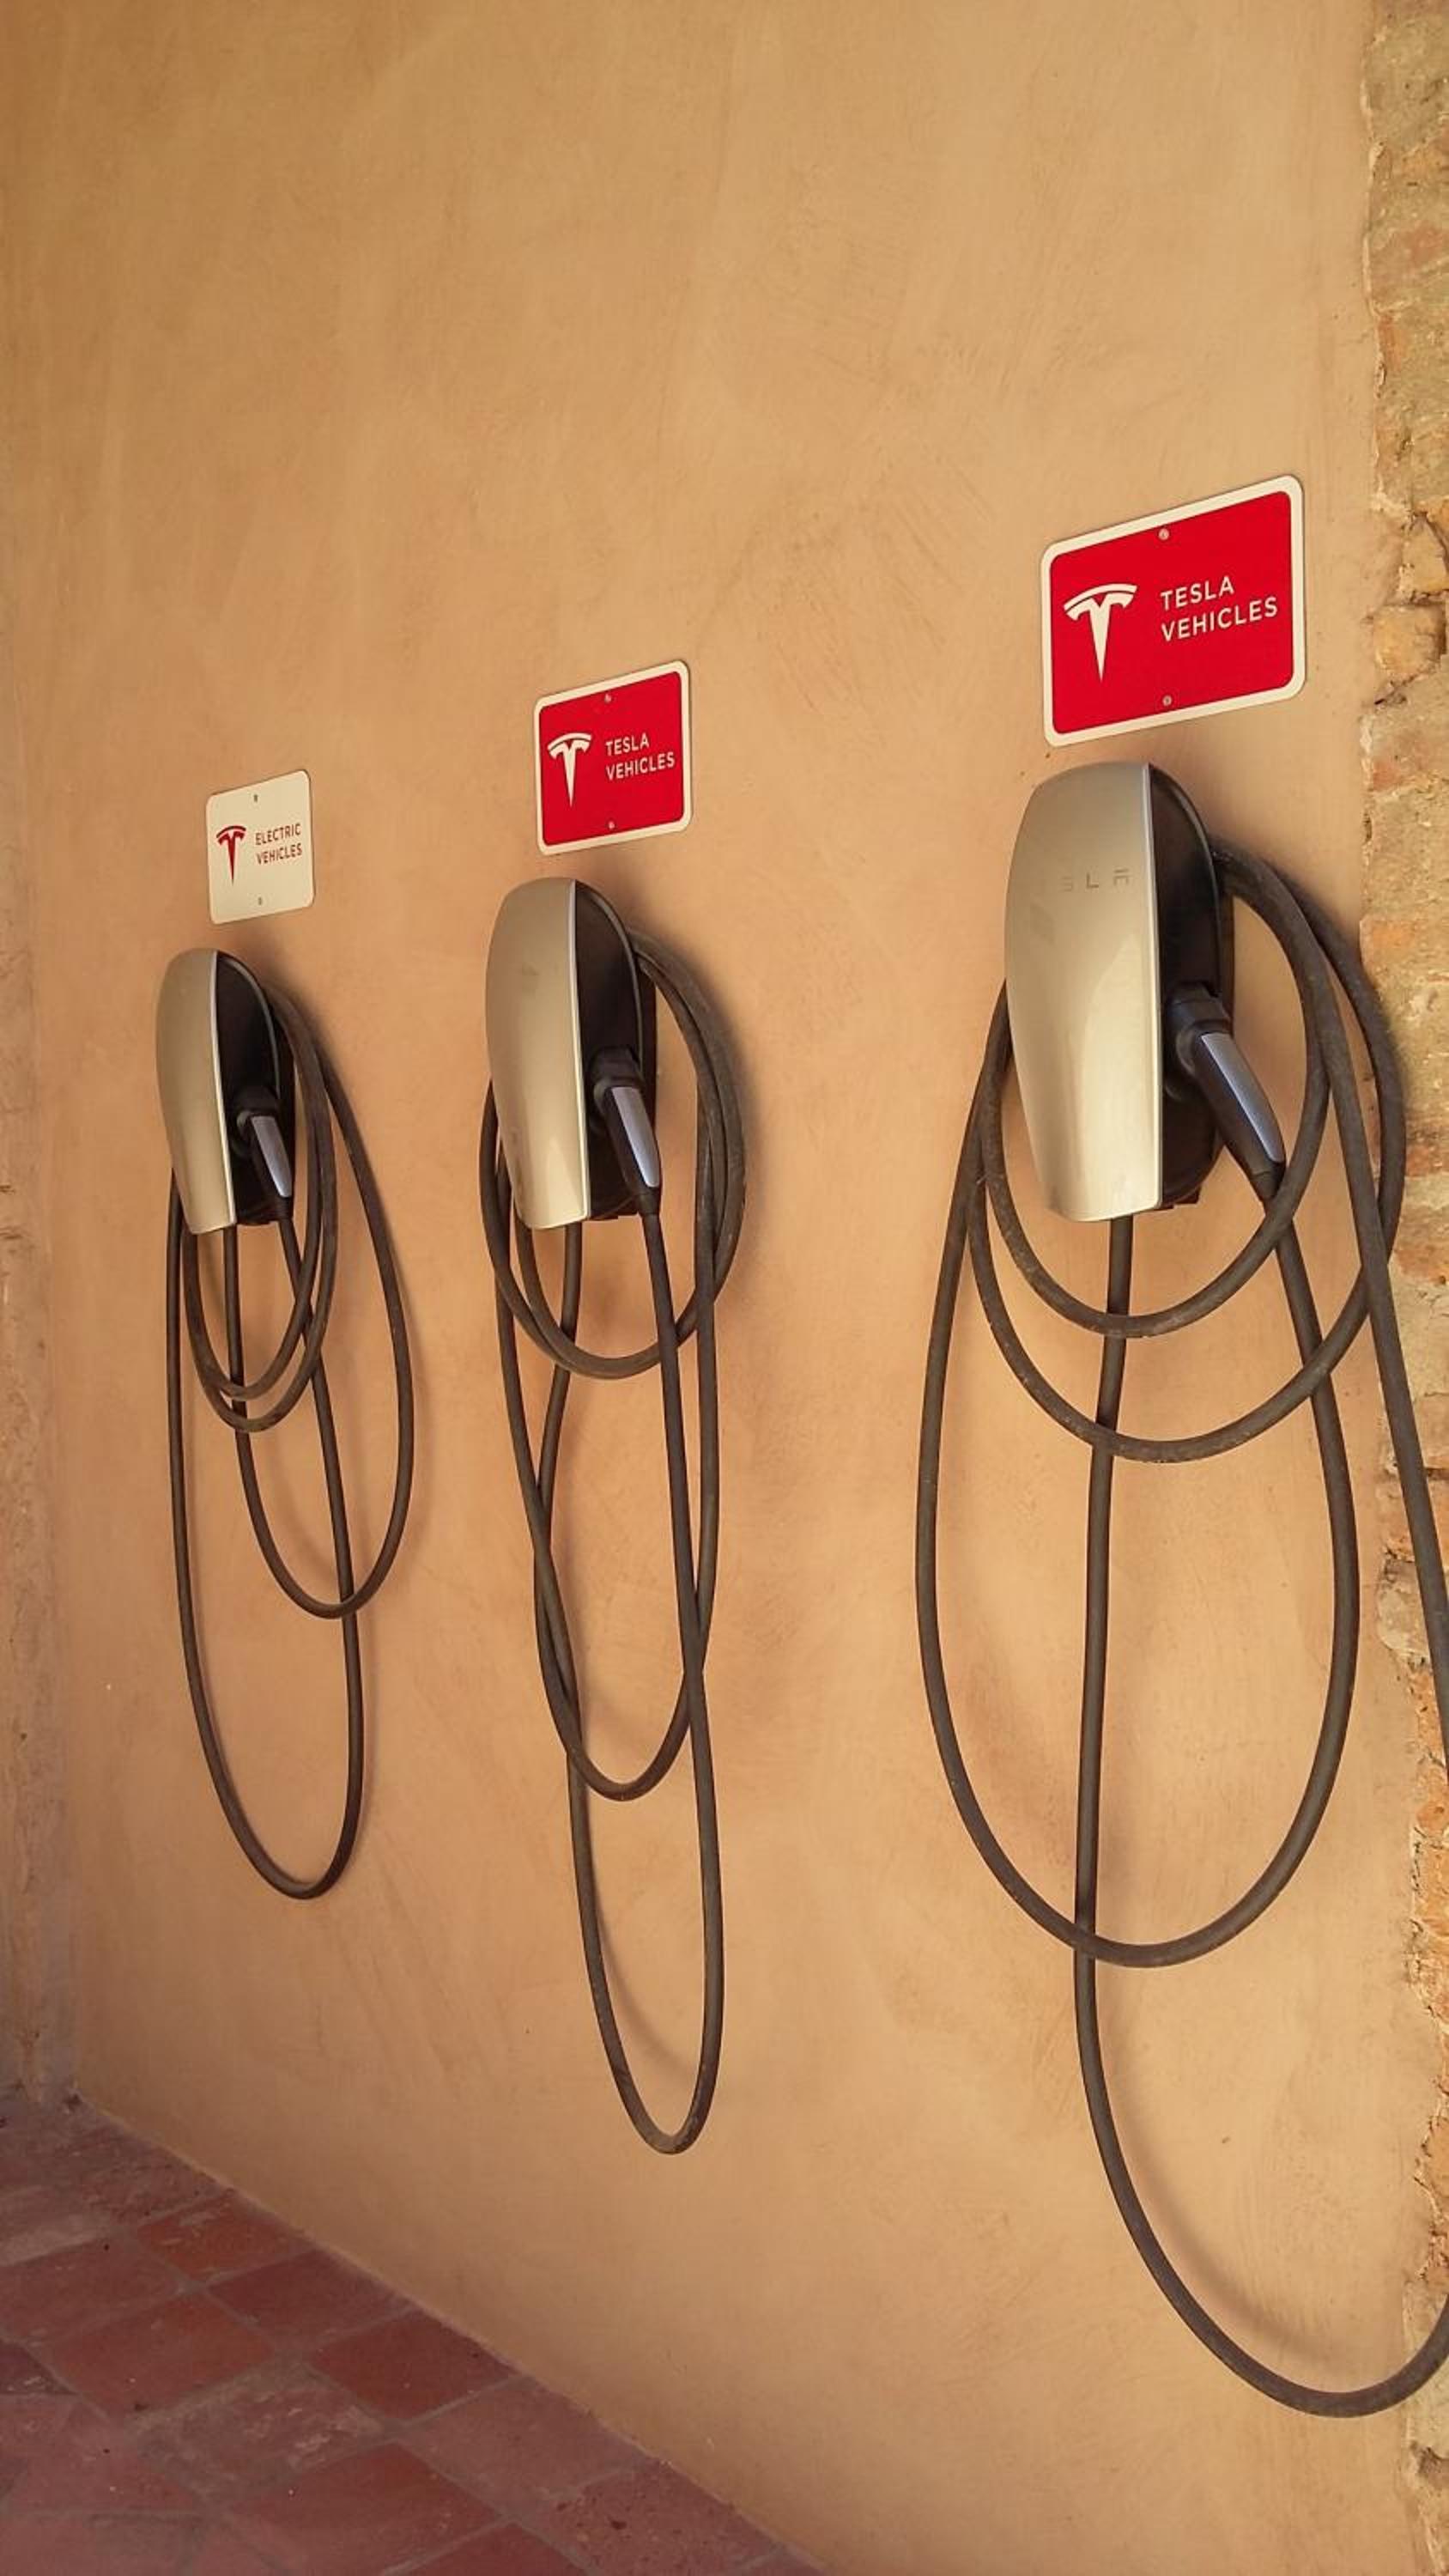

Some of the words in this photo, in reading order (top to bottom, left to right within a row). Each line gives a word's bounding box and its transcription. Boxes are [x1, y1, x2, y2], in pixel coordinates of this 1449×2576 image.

[1160, 575, 1235, 611] TESLA
[1161, 596, 1279, 642] VEHICLES
[605, 732, 650, 756] TESLA
[605, 750, 676, 781] VEHICLES
[255, 822, 301, 846] ELECTRIC
[255, 842, 303, 866] VEHICLES
